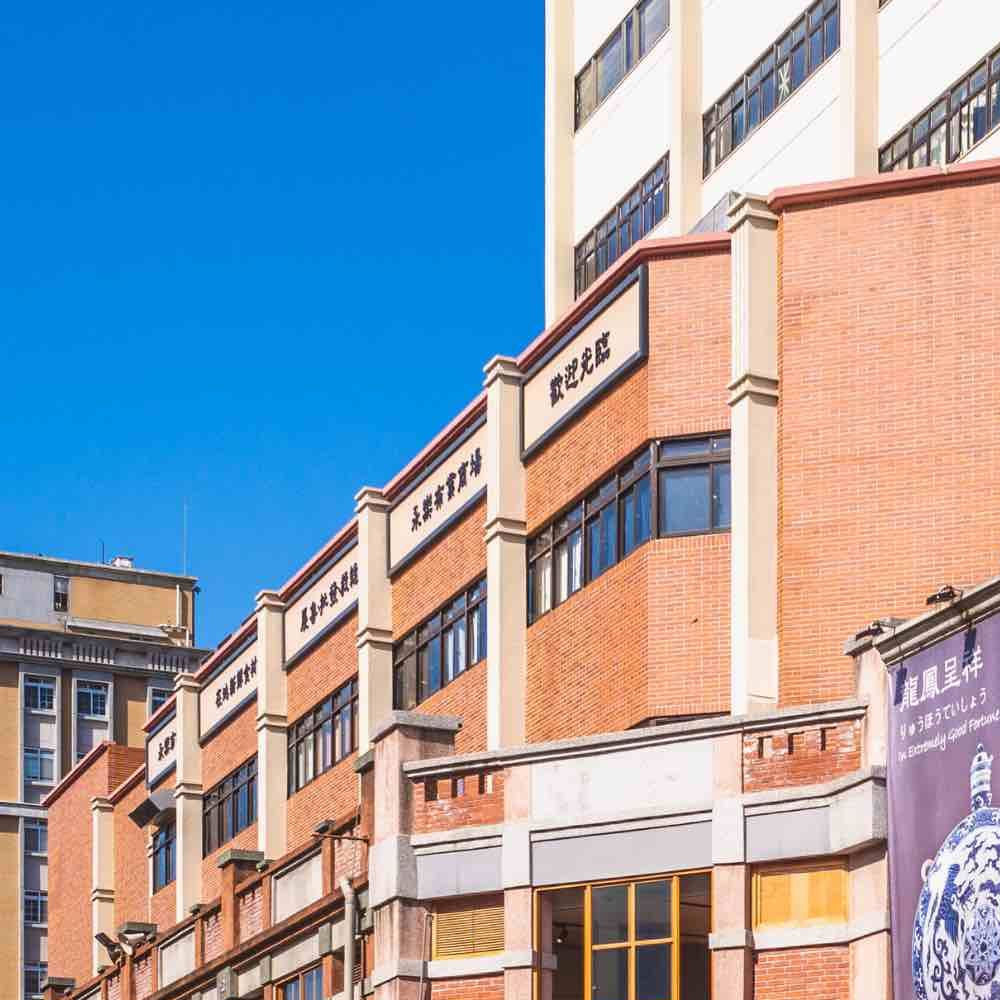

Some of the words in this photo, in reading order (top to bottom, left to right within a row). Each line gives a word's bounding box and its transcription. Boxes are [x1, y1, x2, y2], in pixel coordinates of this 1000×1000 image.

[550, 331, 610, 408] 歡迎光臨
[900, 646, 984, 712] 龍鳳呈祥
[947, 724, 967, 741] Good
